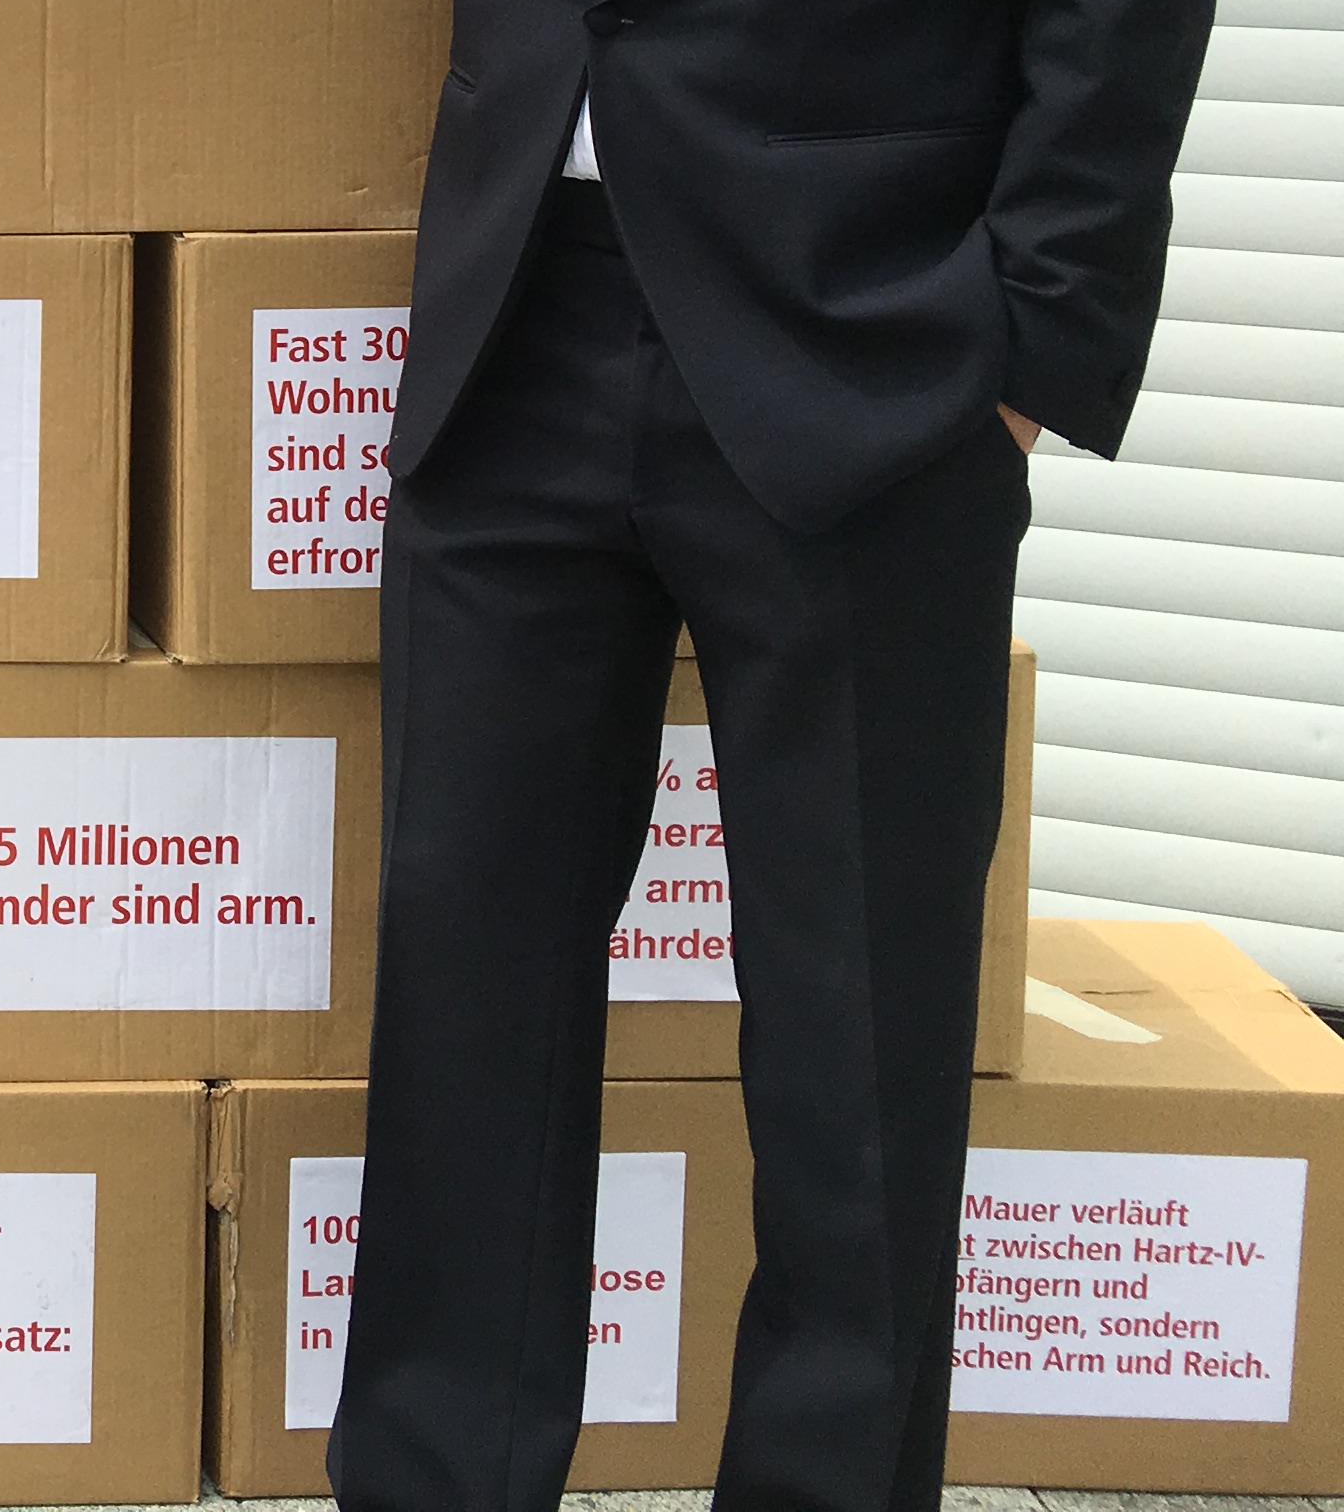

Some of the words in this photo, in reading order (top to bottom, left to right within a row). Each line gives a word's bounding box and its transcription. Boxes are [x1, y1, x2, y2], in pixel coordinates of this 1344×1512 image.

[269, 327, 347, 363] Fast
[267, 434, 346, 472] sind
[267, 485, 331, 524] auf
[266, 537, 379, 576] erfror
[37, 823, 240, 866] Millionen
[111, 882, 200, 925] sind
[217, 894, 316, 925] arm.
[964, 1194, 1060, 1223] Mauer
[1071, 1198, 1189, 1228] verläuft
[985, 1234, 1122, 1262] zwischen
[1133, 1237, 1265, 1267] Hartz-IV-
[1092, 1273, 1149, 1300] und
[301, 1322, 333, 1350] in
[957, 1303, 1086, 1341] htlingen,
[1099, 1311, 1220, 1340] sondern
[1042, 1346, 1105, 1373] Arm
[1115, 1349, 1173, 1376] und
[1182, 1349, 1270, 1380] Reich.
